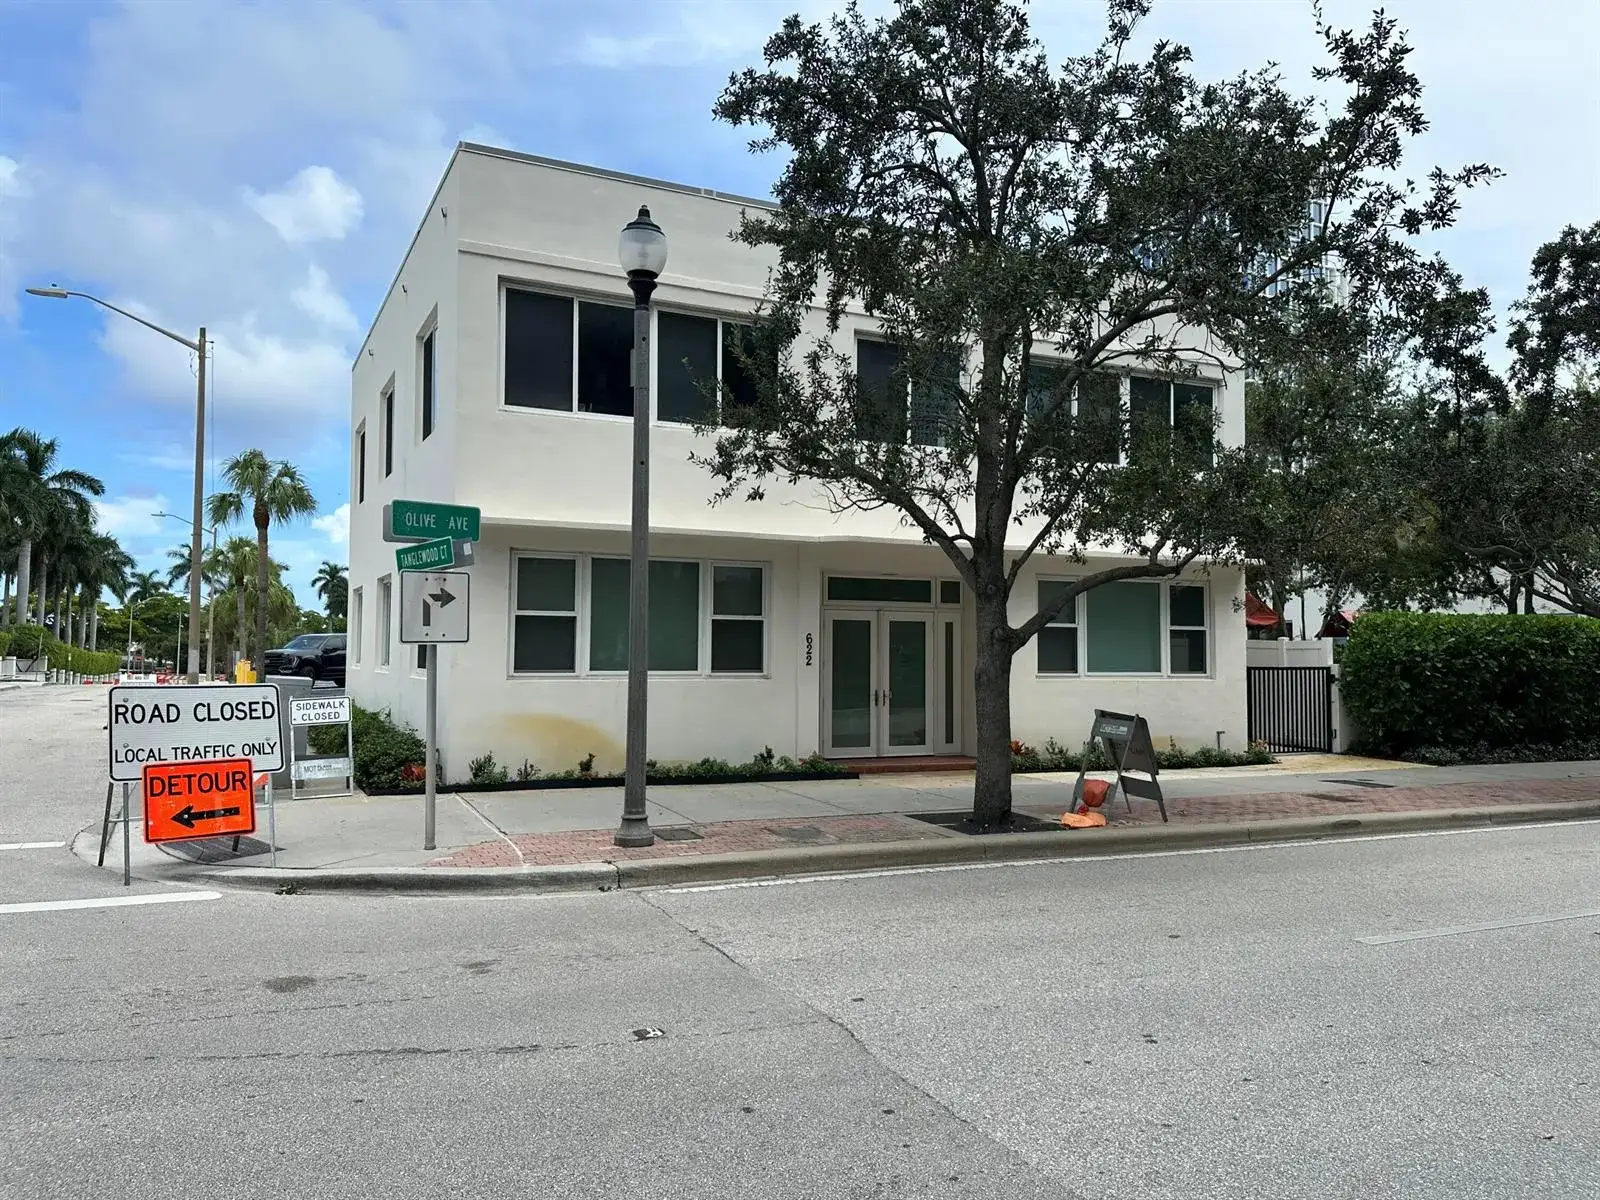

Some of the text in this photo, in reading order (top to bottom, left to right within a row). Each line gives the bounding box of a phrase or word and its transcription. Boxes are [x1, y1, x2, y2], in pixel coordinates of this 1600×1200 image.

[405, 512, 469, 531] OLIVE AVE
[401, 545, 448, 567] TANGLEWOOD CT
[805, 632, 813, 666] 622
[114, 701, 276, 724] ROAD CLOSED
[296, 700, 345, 711] SIDEWALK
[301, 711, 340, 721] CLOSED
[115, 741, 277, 763] LOCAL TRAFFIC ONLY
[149, 770, 248, 797] DETOUR
